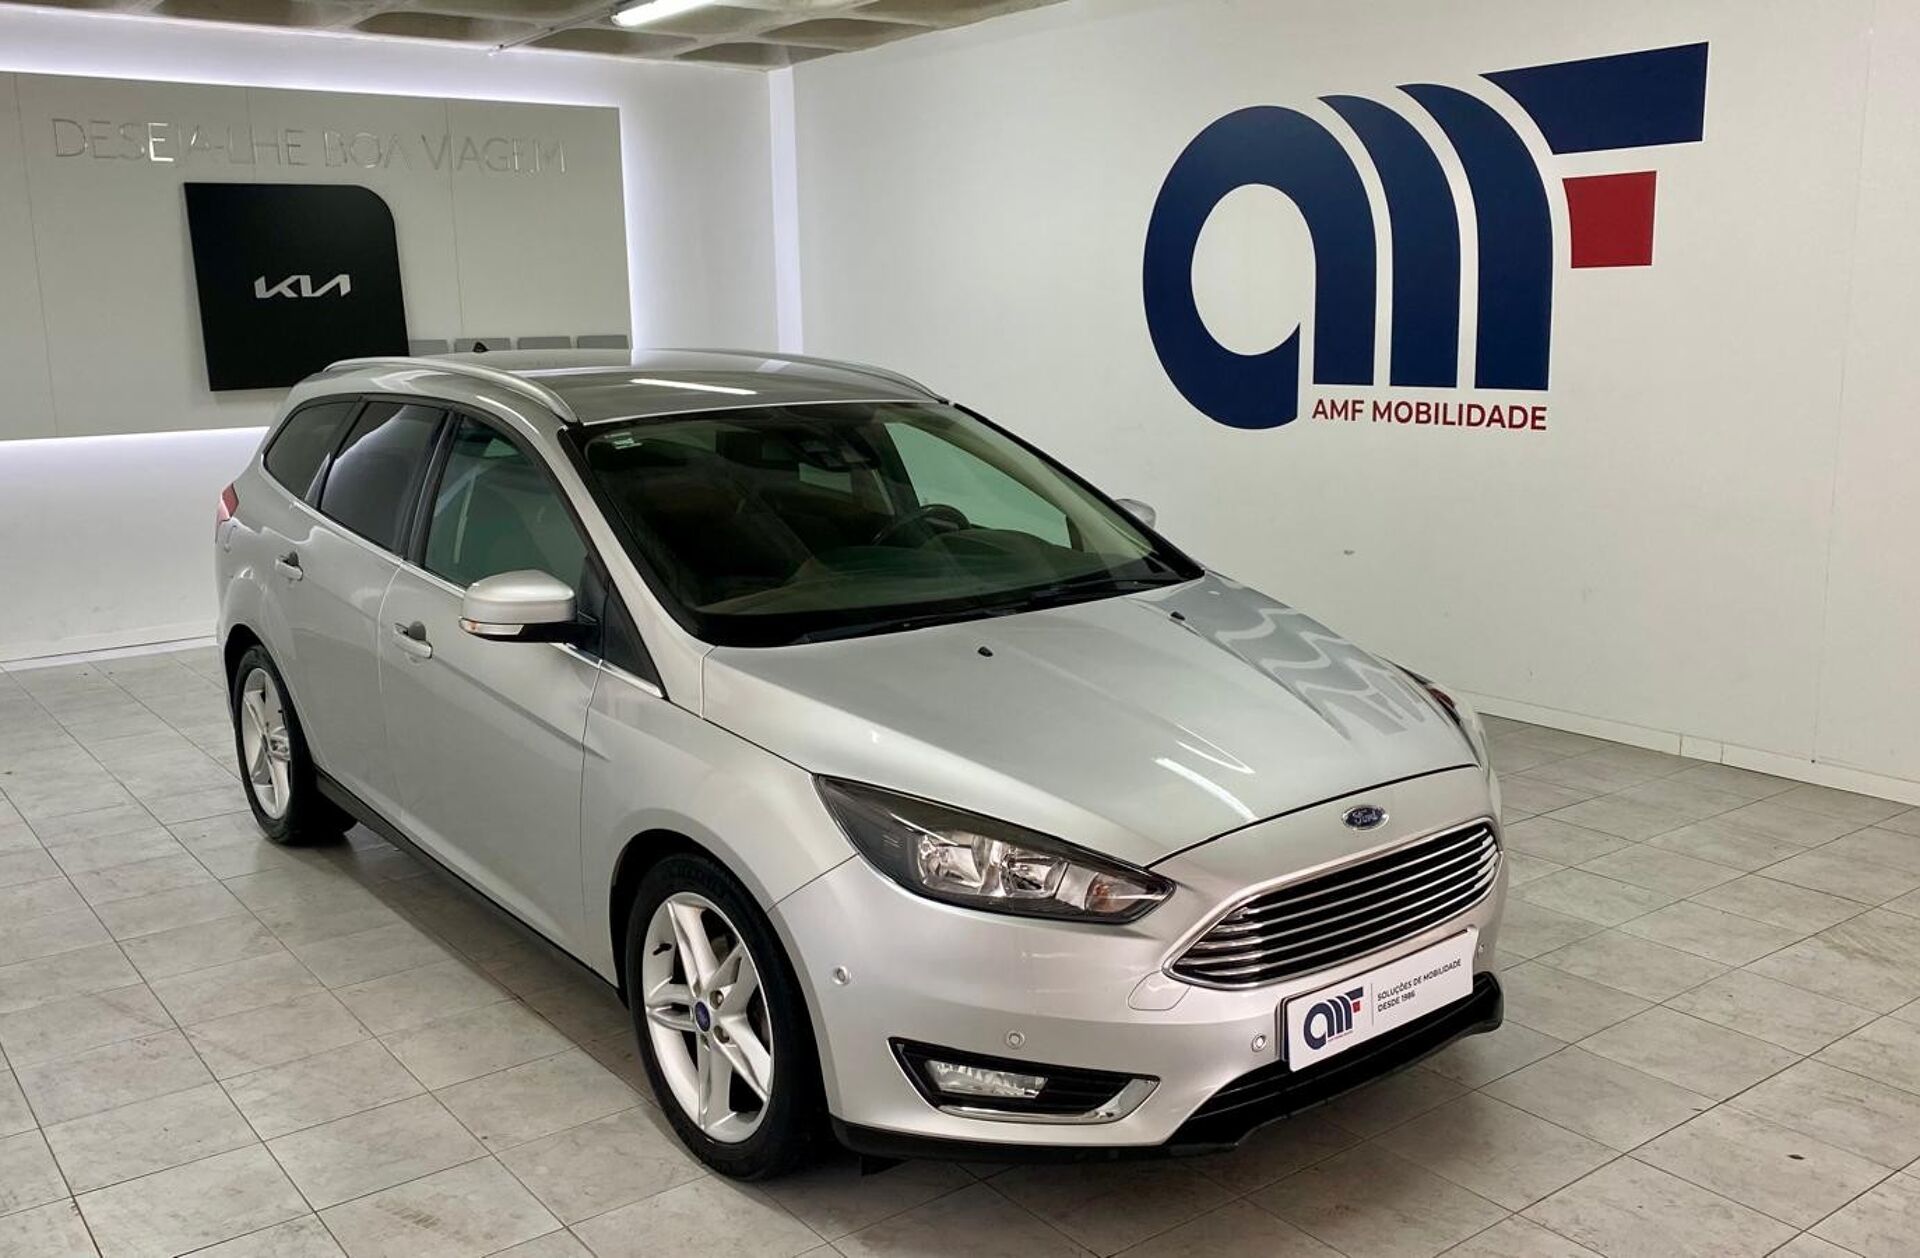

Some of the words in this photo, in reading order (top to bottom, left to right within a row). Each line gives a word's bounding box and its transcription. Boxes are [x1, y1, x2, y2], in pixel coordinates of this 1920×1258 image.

[253, 274, 351, 299] KIA
[1312, 398, 1365, 421] AMF
[1372, 399, 1548, 431] MOBILIDADE
[1413, 975, 1422, 987] DE
[1423, 958, 1462, 981] MOBILIDADE
[1377, 996, 1401, 1013] DESDE
